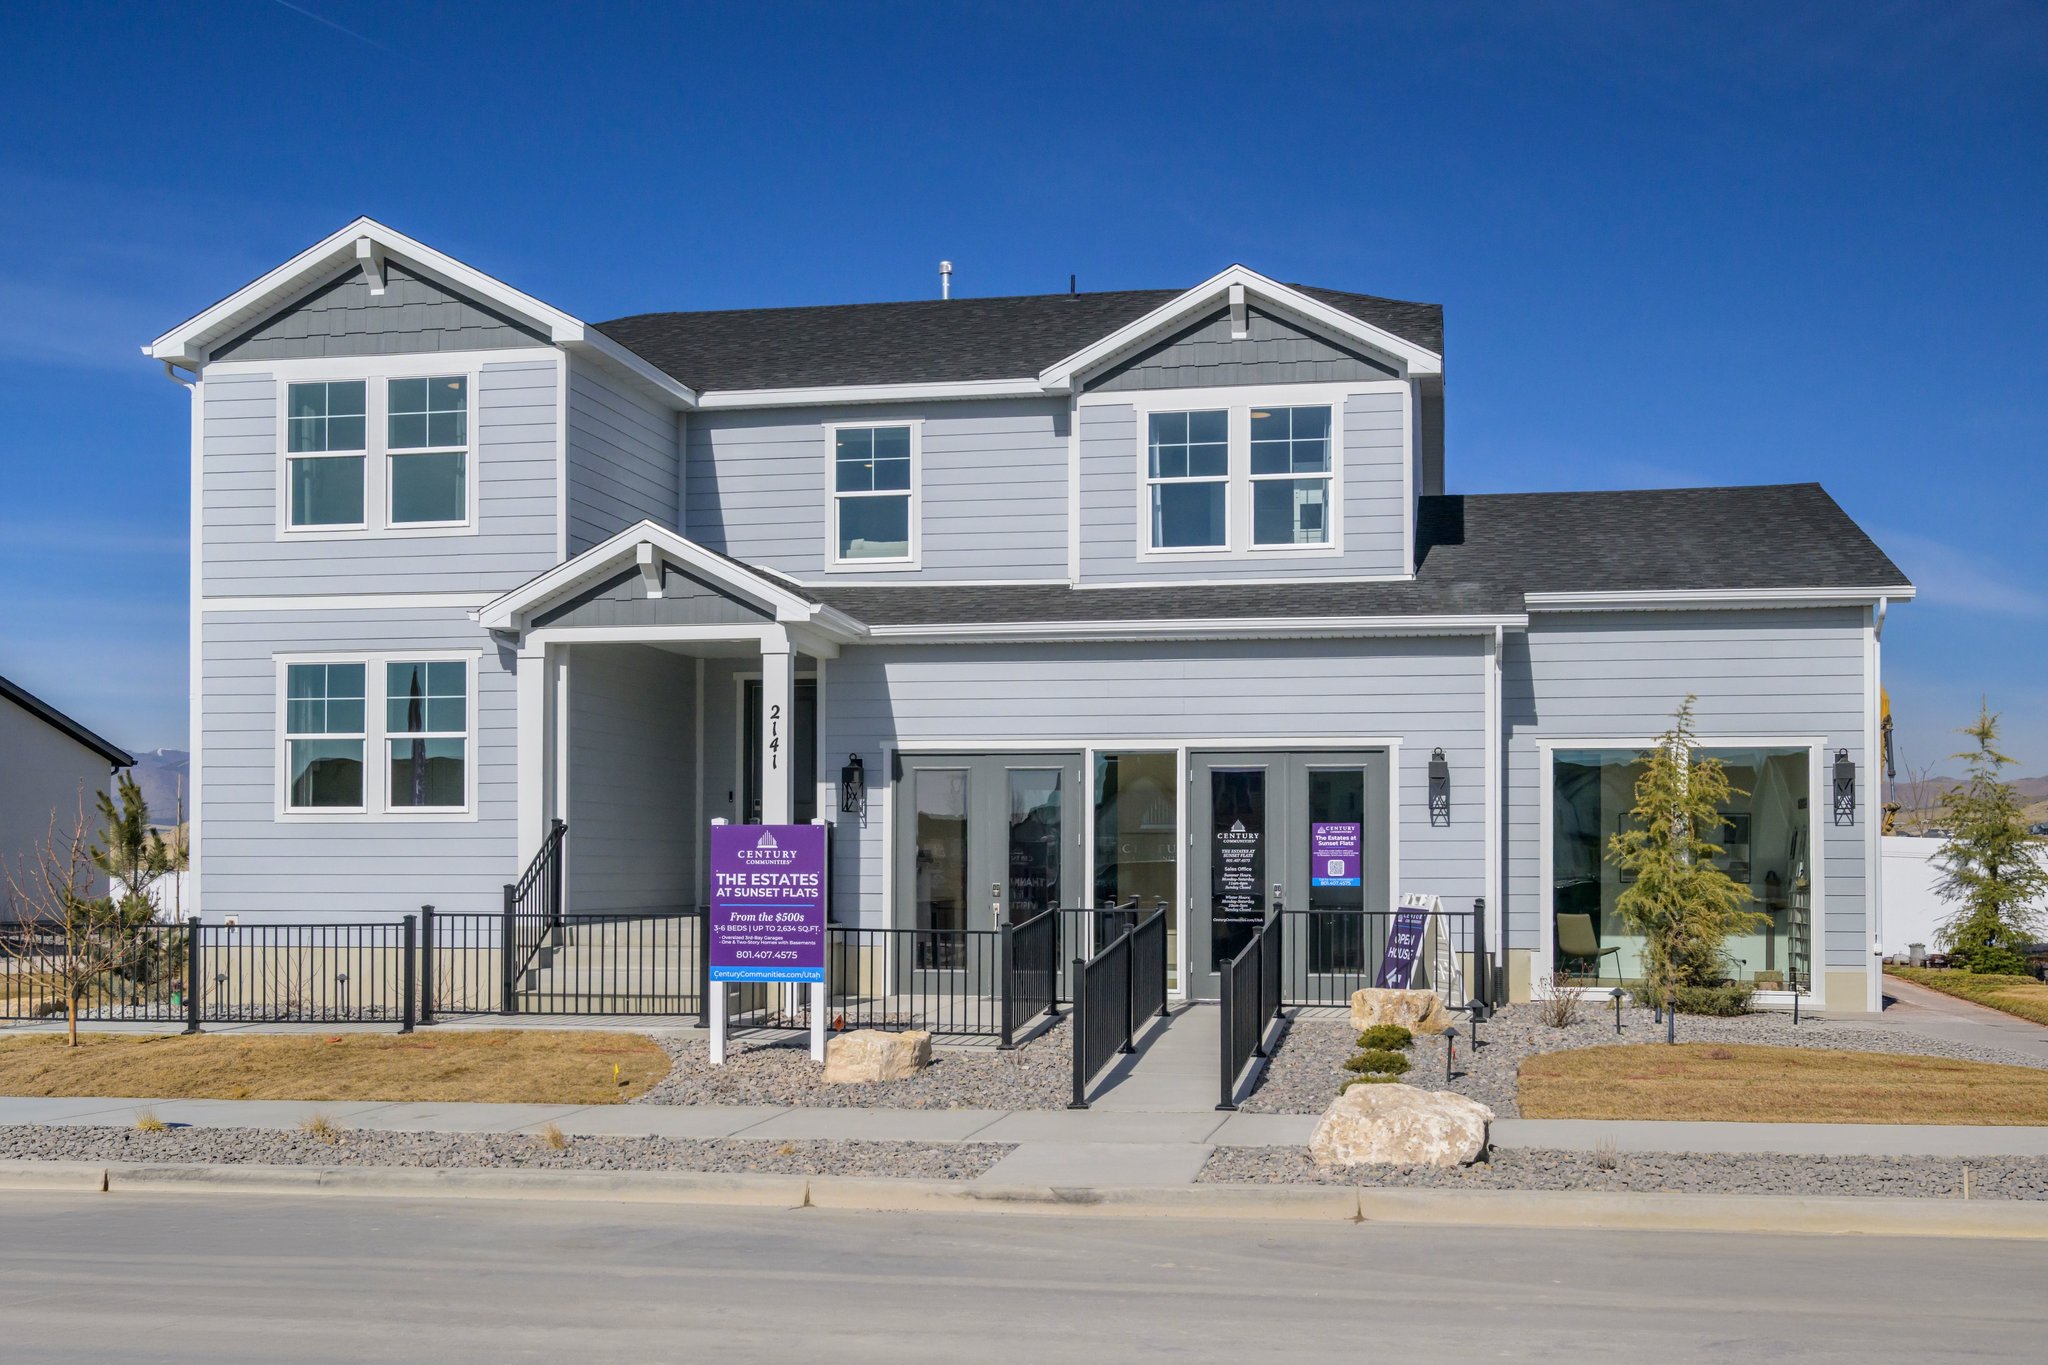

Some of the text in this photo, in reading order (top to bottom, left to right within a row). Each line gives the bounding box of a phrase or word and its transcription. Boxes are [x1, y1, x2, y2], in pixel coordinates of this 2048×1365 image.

[769, 705, 780, 770] 2141
[737, 850, 797, 858] CENTURY
[716, 874, 818, 885] THE ESTATES
[716, 888, 818, 897] AT SUNSET FLATS
[730, 912, 804, 922] From the $500s
[736, 951, 798, 959] 801.407.4575
